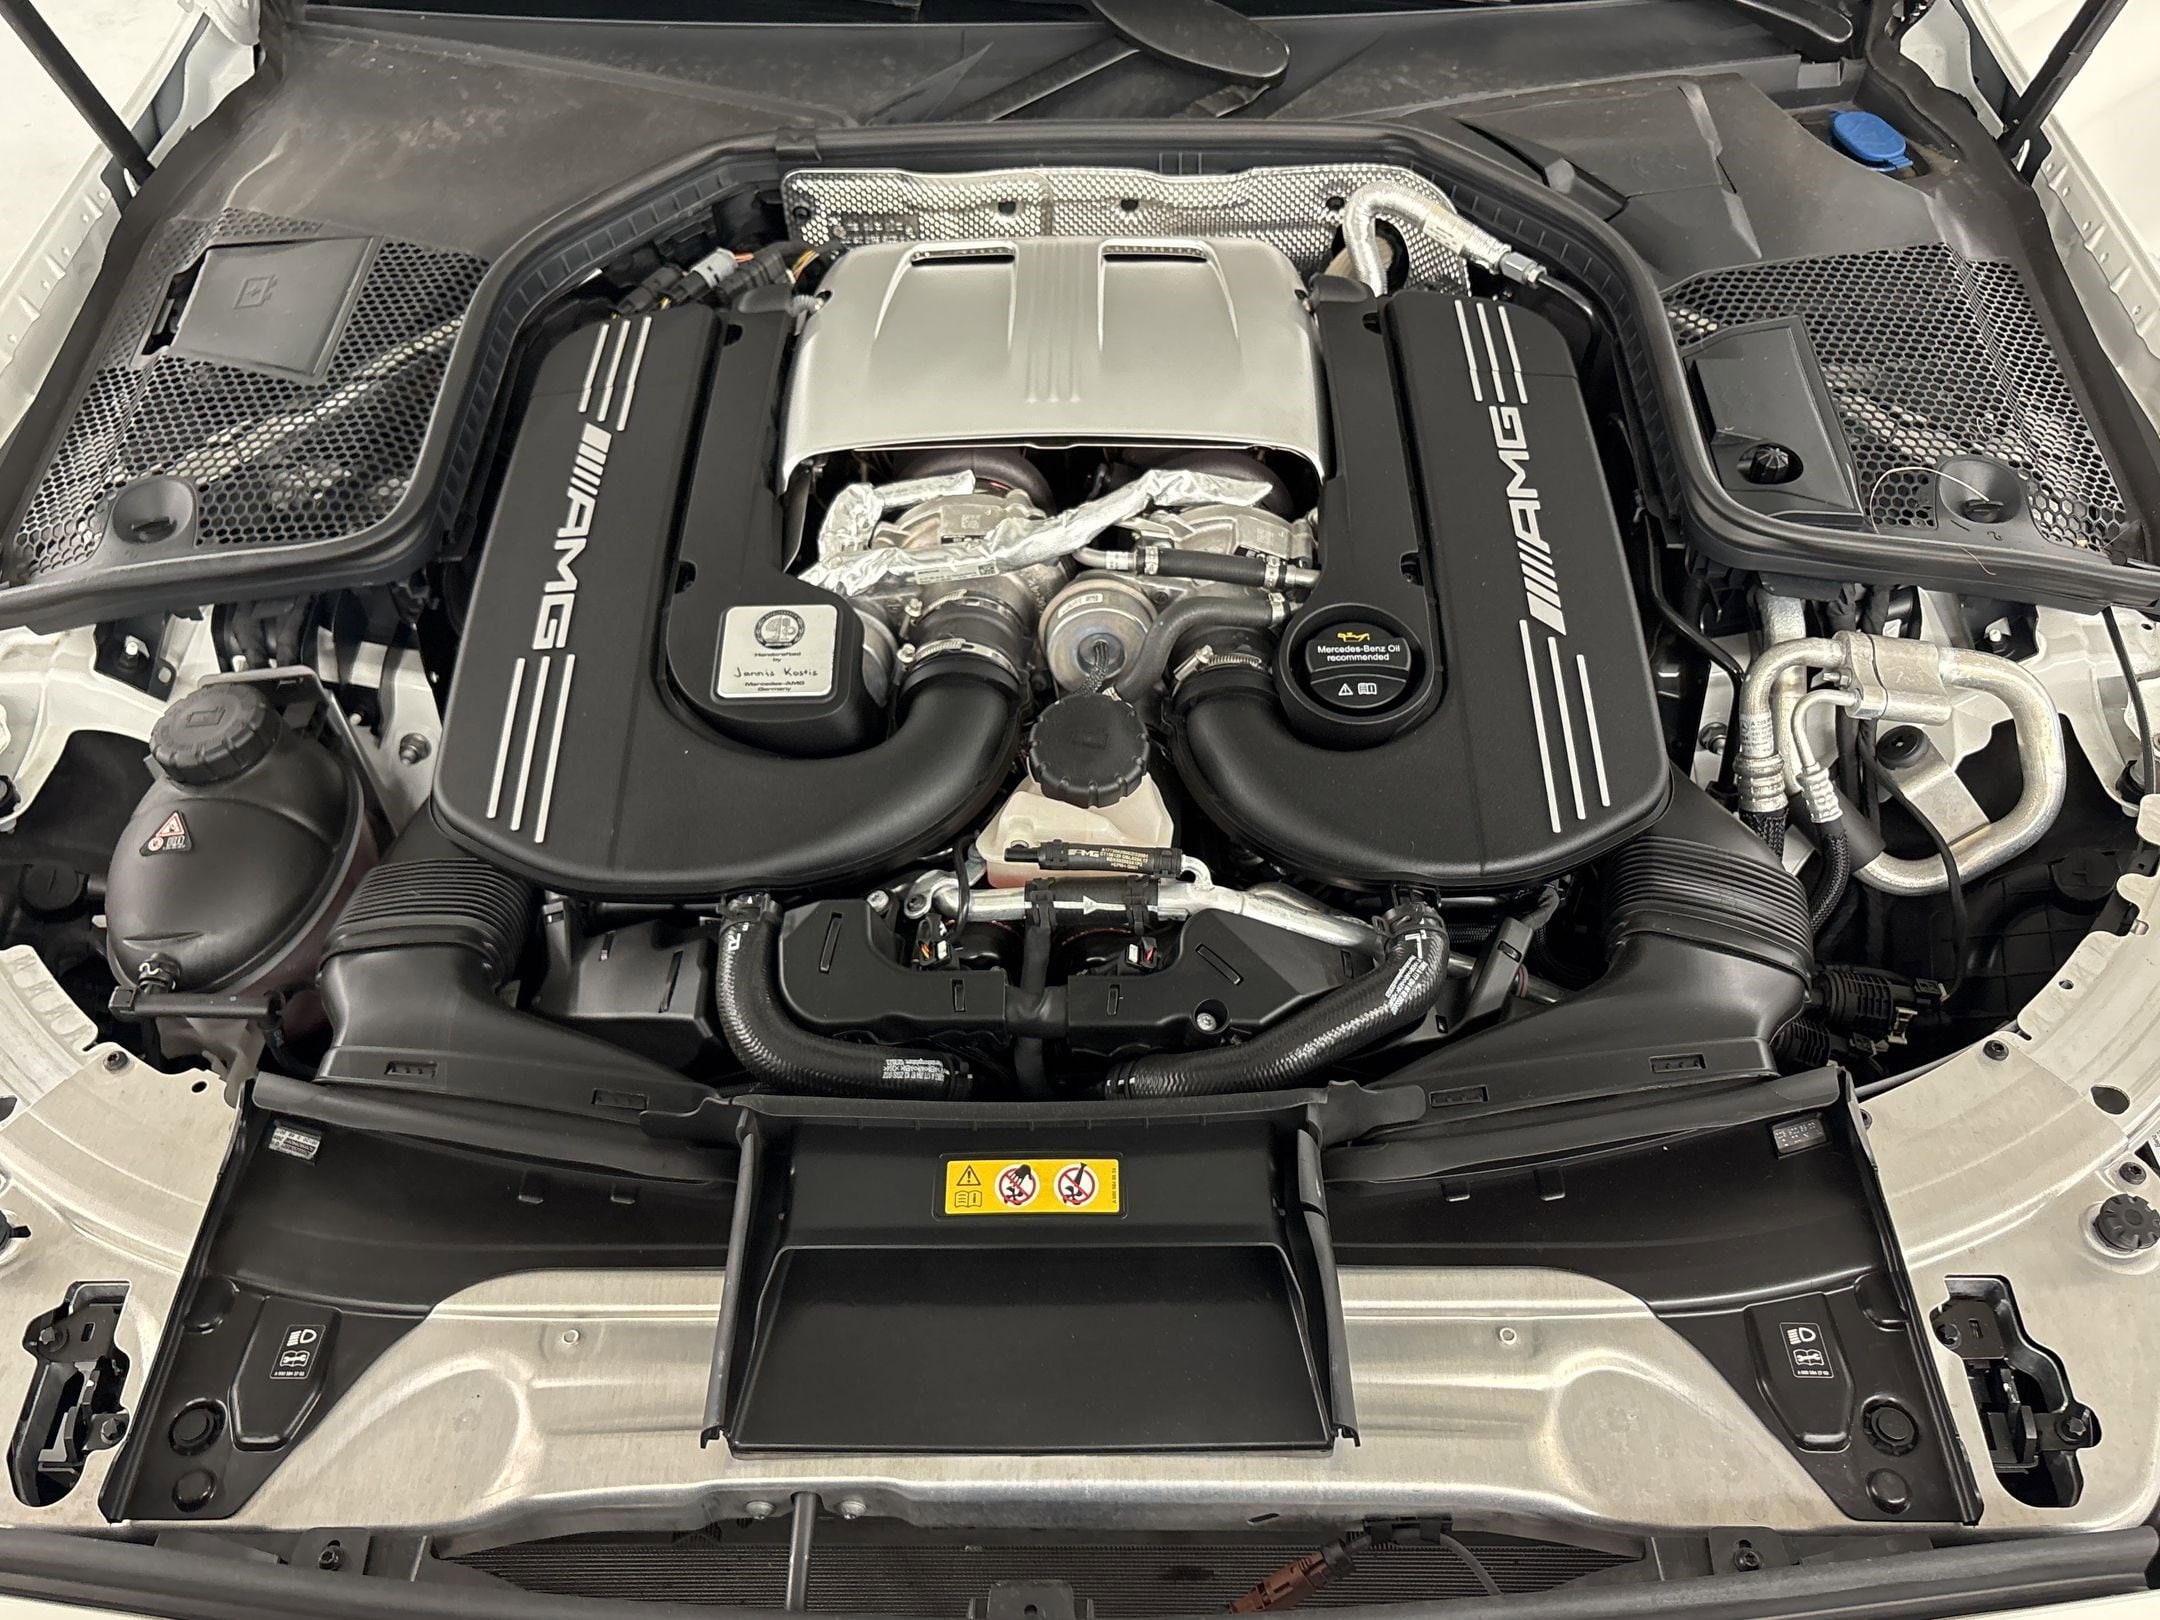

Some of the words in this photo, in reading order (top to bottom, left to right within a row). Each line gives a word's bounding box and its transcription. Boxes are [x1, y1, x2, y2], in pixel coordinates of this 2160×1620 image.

[1489, 405, 1551, 554] AMG
[532, 486, 596, 650] AMG
[1317, 644, 1385, 653] Mercedes-Benz
[1388, 644, 1400, 652] Oil
[1327, 653, 1390, 662] recommended
